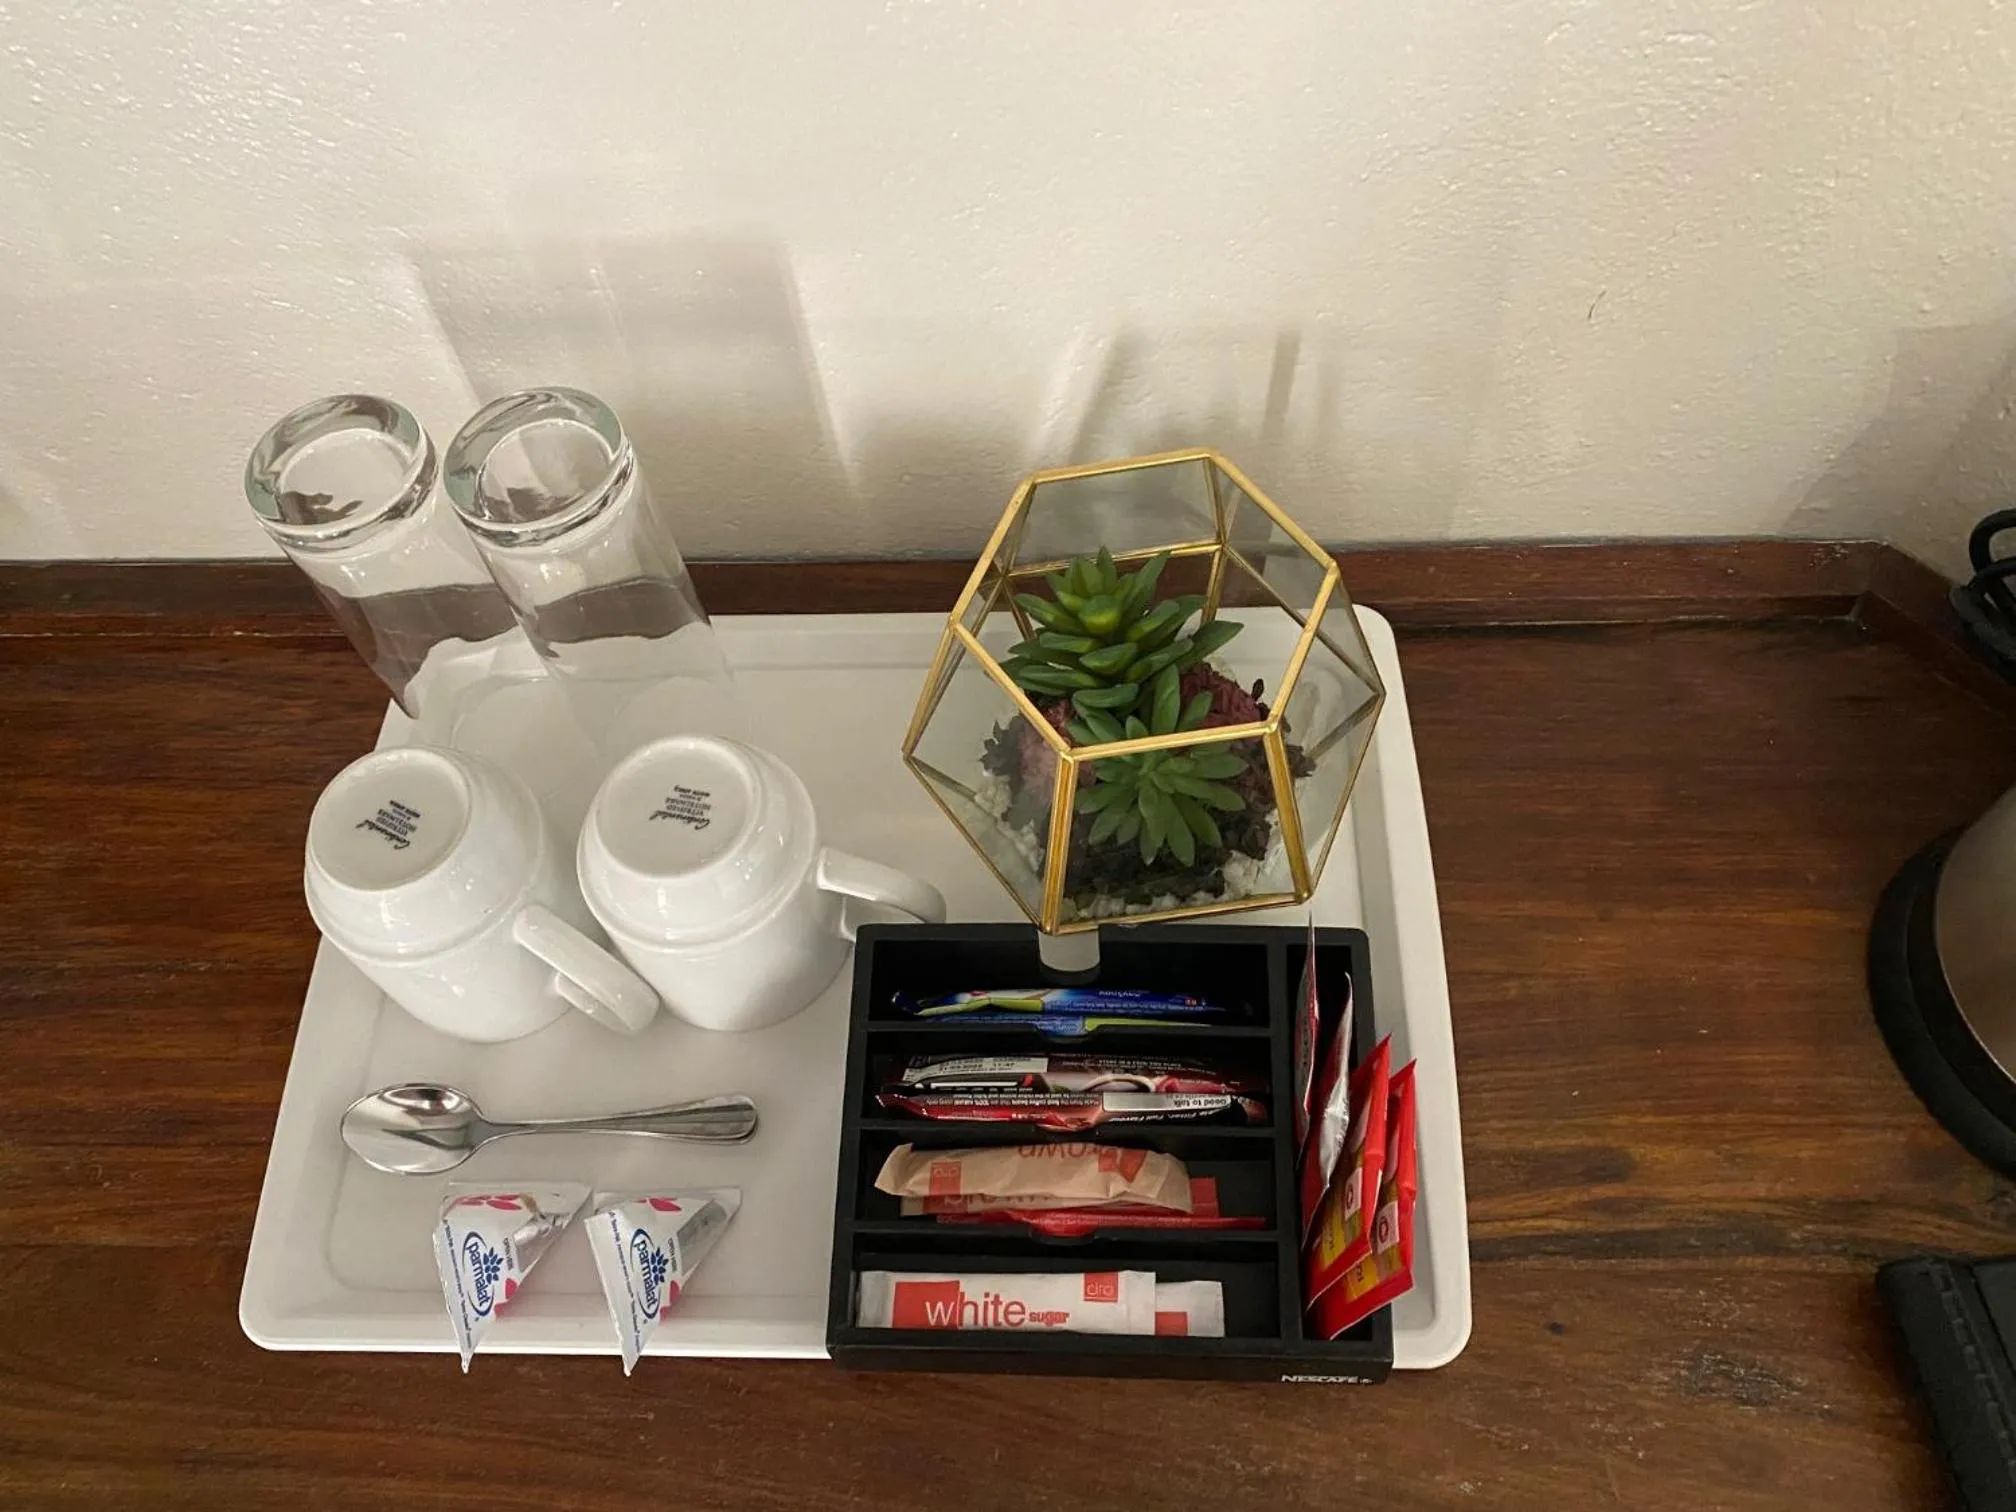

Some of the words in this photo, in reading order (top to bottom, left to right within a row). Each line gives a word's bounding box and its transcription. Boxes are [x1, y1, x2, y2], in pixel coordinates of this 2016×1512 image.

[1174, 1099, 1190, 1107] talk
[1204, 1099, 1227, 1108] Good
[466, 1241, 491, 1308] parmalat
[634, 1239, 658, 1310] parmalat
[924, 1291, 1026, 1328] white
[1028, 1310, 1071, 1327] sugar
